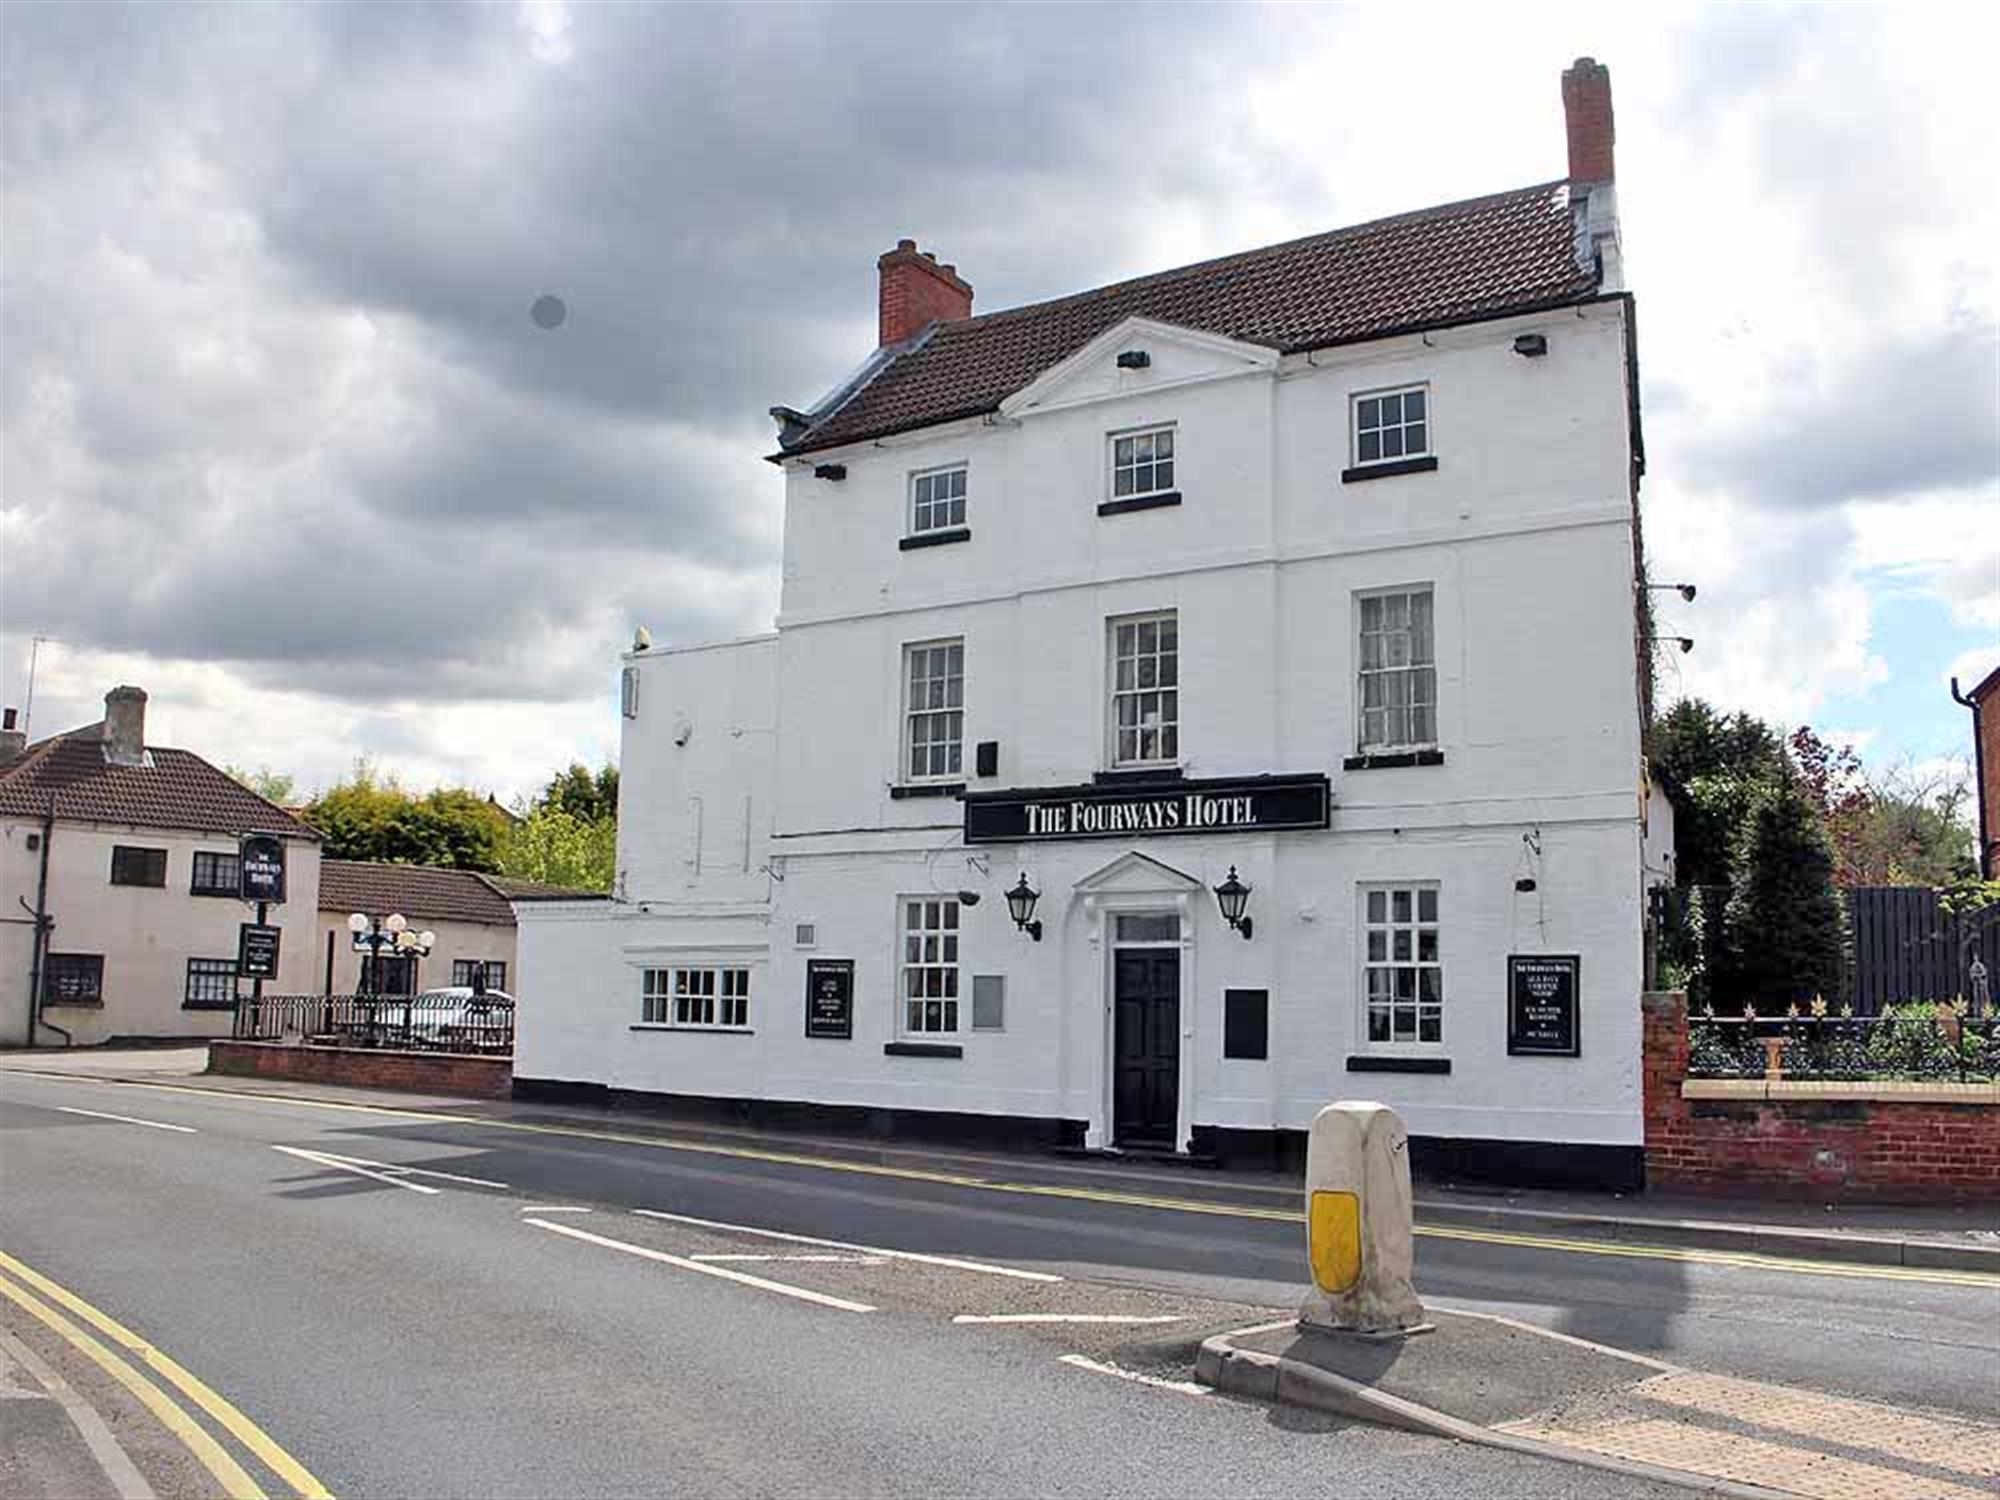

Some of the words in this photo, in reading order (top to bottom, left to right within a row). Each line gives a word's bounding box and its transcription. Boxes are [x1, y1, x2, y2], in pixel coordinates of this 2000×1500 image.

[1025, 804, 1066, 834] THE
[1070, 801, 1179, 832] FOURWAYS
[1185, 795, 1257, 827] HOTEL
